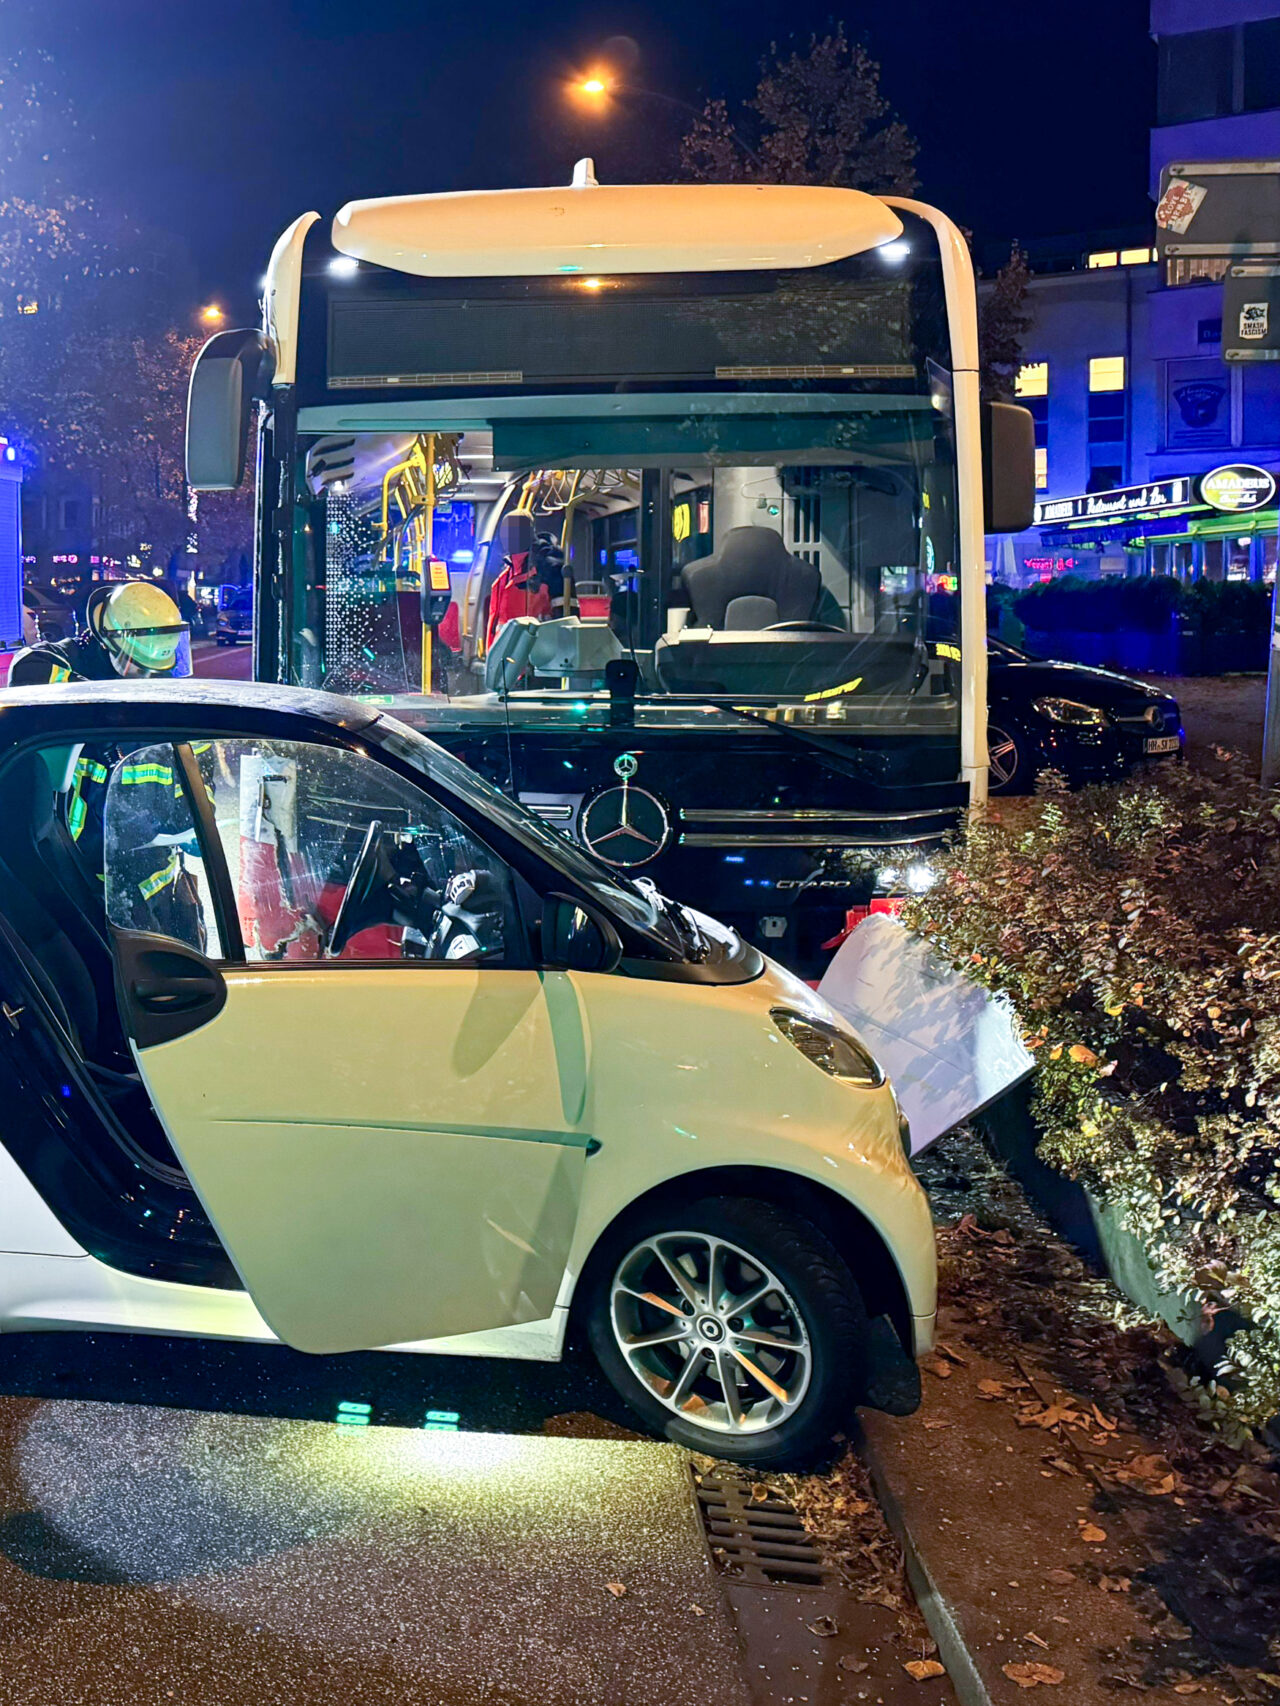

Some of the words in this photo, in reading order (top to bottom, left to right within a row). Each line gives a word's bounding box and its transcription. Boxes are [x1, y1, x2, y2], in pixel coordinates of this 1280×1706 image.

[1241, 328, 1267, 336] FASCISM
[1206, 478, 1270, 489] AMADEUS
[776, 879, 851, 889] CITARO
